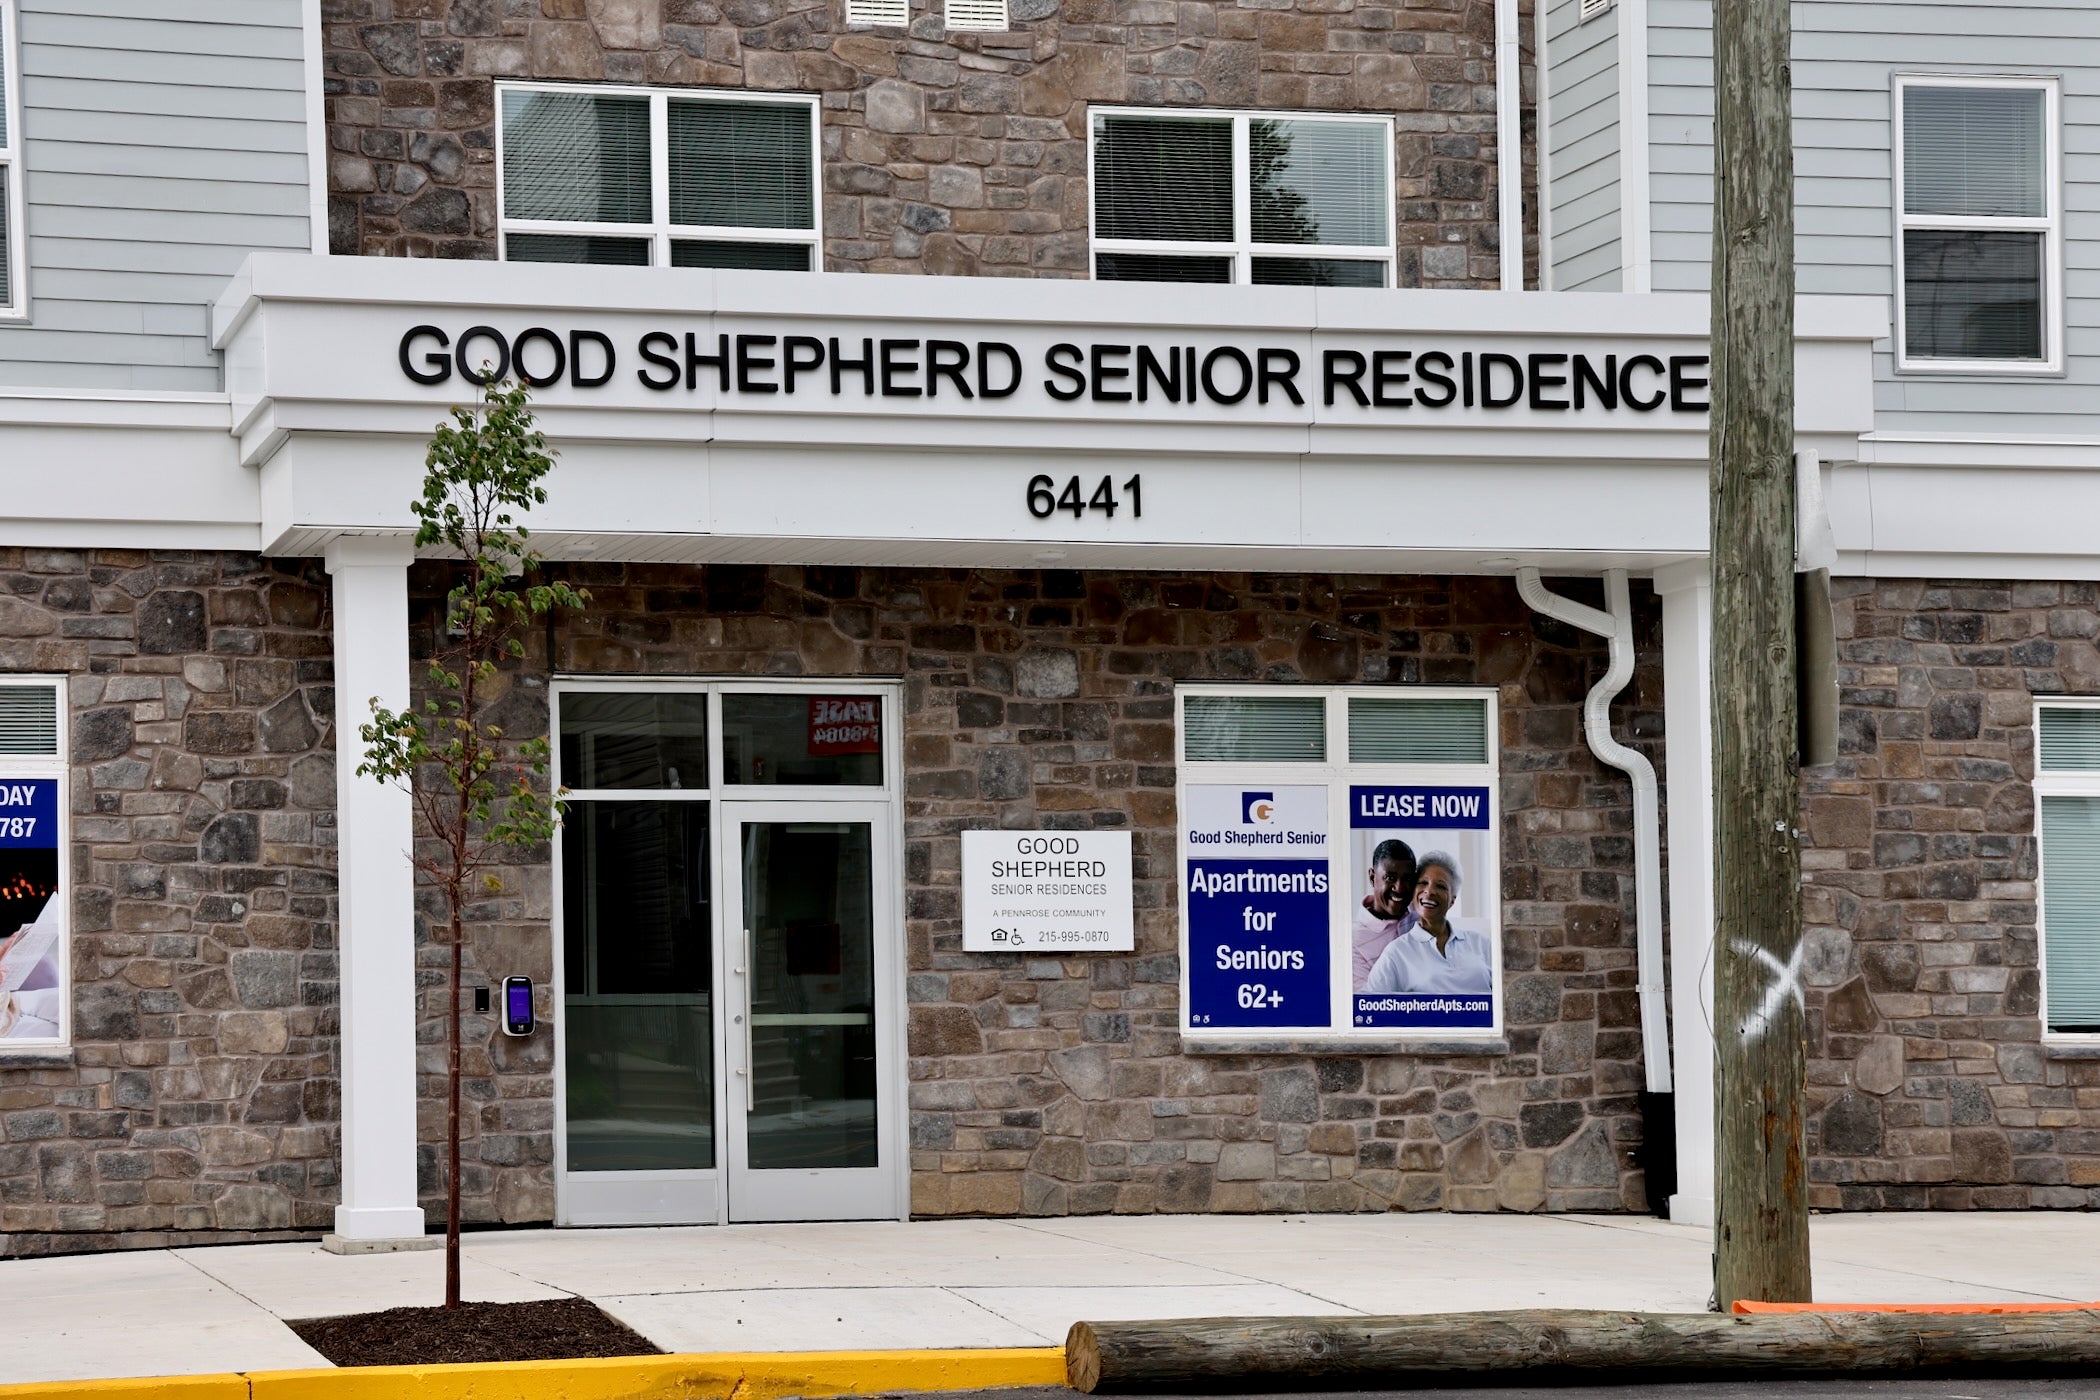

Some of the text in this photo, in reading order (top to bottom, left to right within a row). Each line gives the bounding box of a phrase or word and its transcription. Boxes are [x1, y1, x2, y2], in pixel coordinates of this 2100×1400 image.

[399, 325, 1710, 412] GOOD SHEPHERD SENIOR RESIDENCE
[1026, 473, 1142, 519] 6441
[1361, 794, 1480, 818] LEASE NOW
[0, 817, 37, 838] 787
[1017, 837, 1080, 855] GOOD
[1189, 830, 1327, 847] Good Shepherd Senior
[991, 860, 1106, 878] SHEPHERD
[991, 883, 1107, 895] SENIOR RESIDENCES
[1190, 867, 1328, 898] Apartments
[992, 909, 1106, 918] A PENNROSE COMMUNITY
[1242, 906, 1277, 932] for
[1038, 931, 1110, 943] 215-995-0870
[1216, 944, 1305, 970] Seniors
[1237, 983, 1284, 1009] 62+
[1358, 998, 1489, 1013] GoodShepherdApts.com
